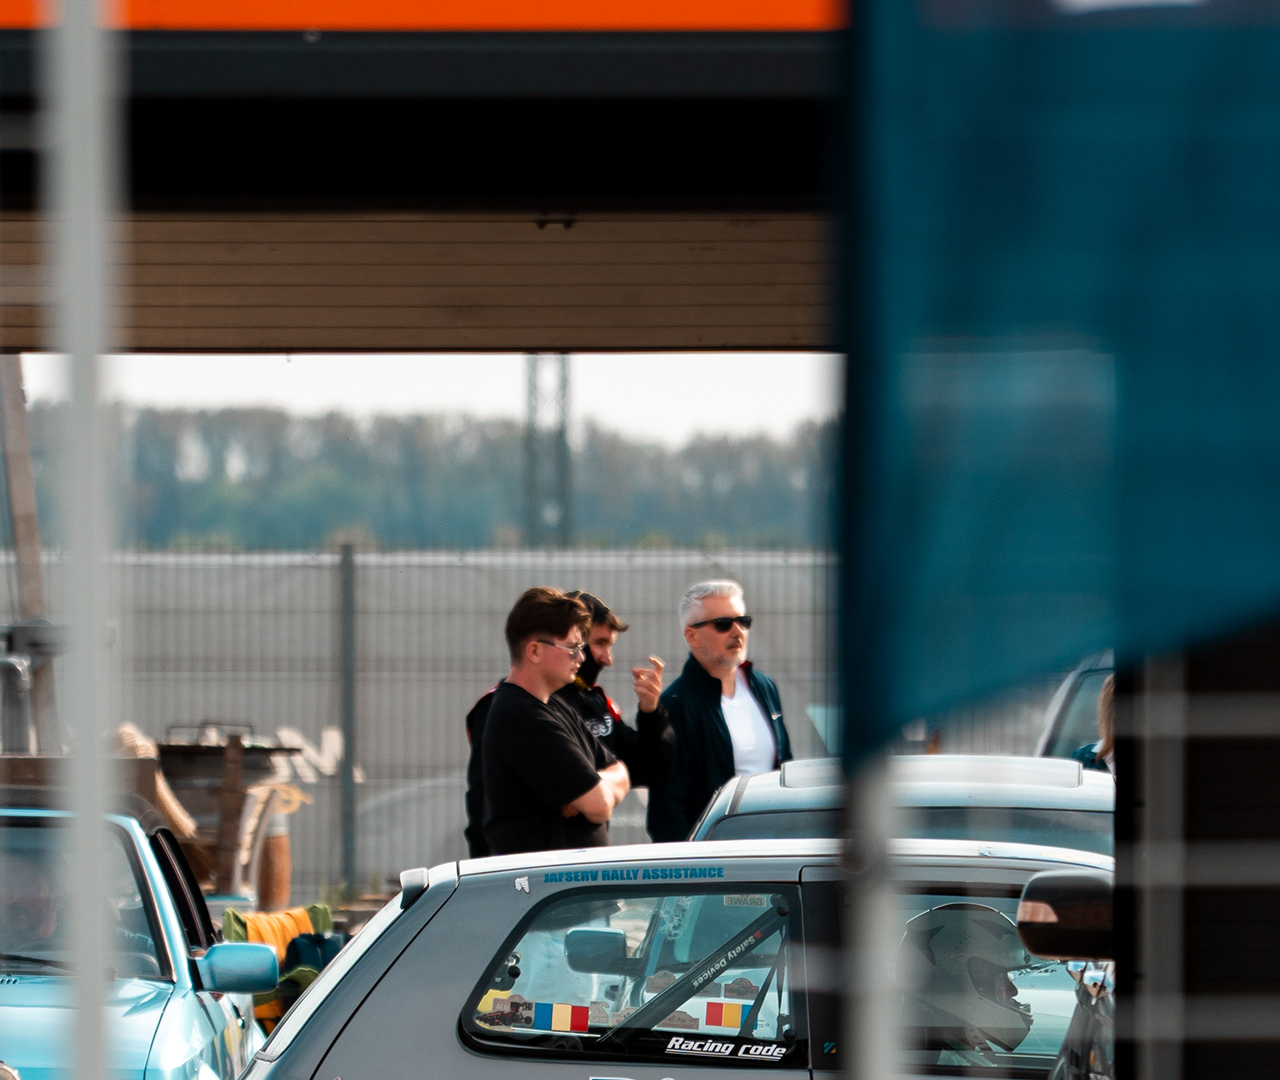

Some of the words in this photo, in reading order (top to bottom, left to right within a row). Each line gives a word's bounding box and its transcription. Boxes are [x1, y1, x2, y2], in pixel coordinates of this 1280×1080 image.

[544, 870, 599, 883] JAFSERV
[601, 869, 639, 881] RALLY
[642, 867, 724, 880] ASSISTANCE
[727, 935, 757, 961] Safety
[692, 958, 728, 988] Devices
[667, 1036, 735, 1056] Racing
[737, 1044, 787, 1059] code
